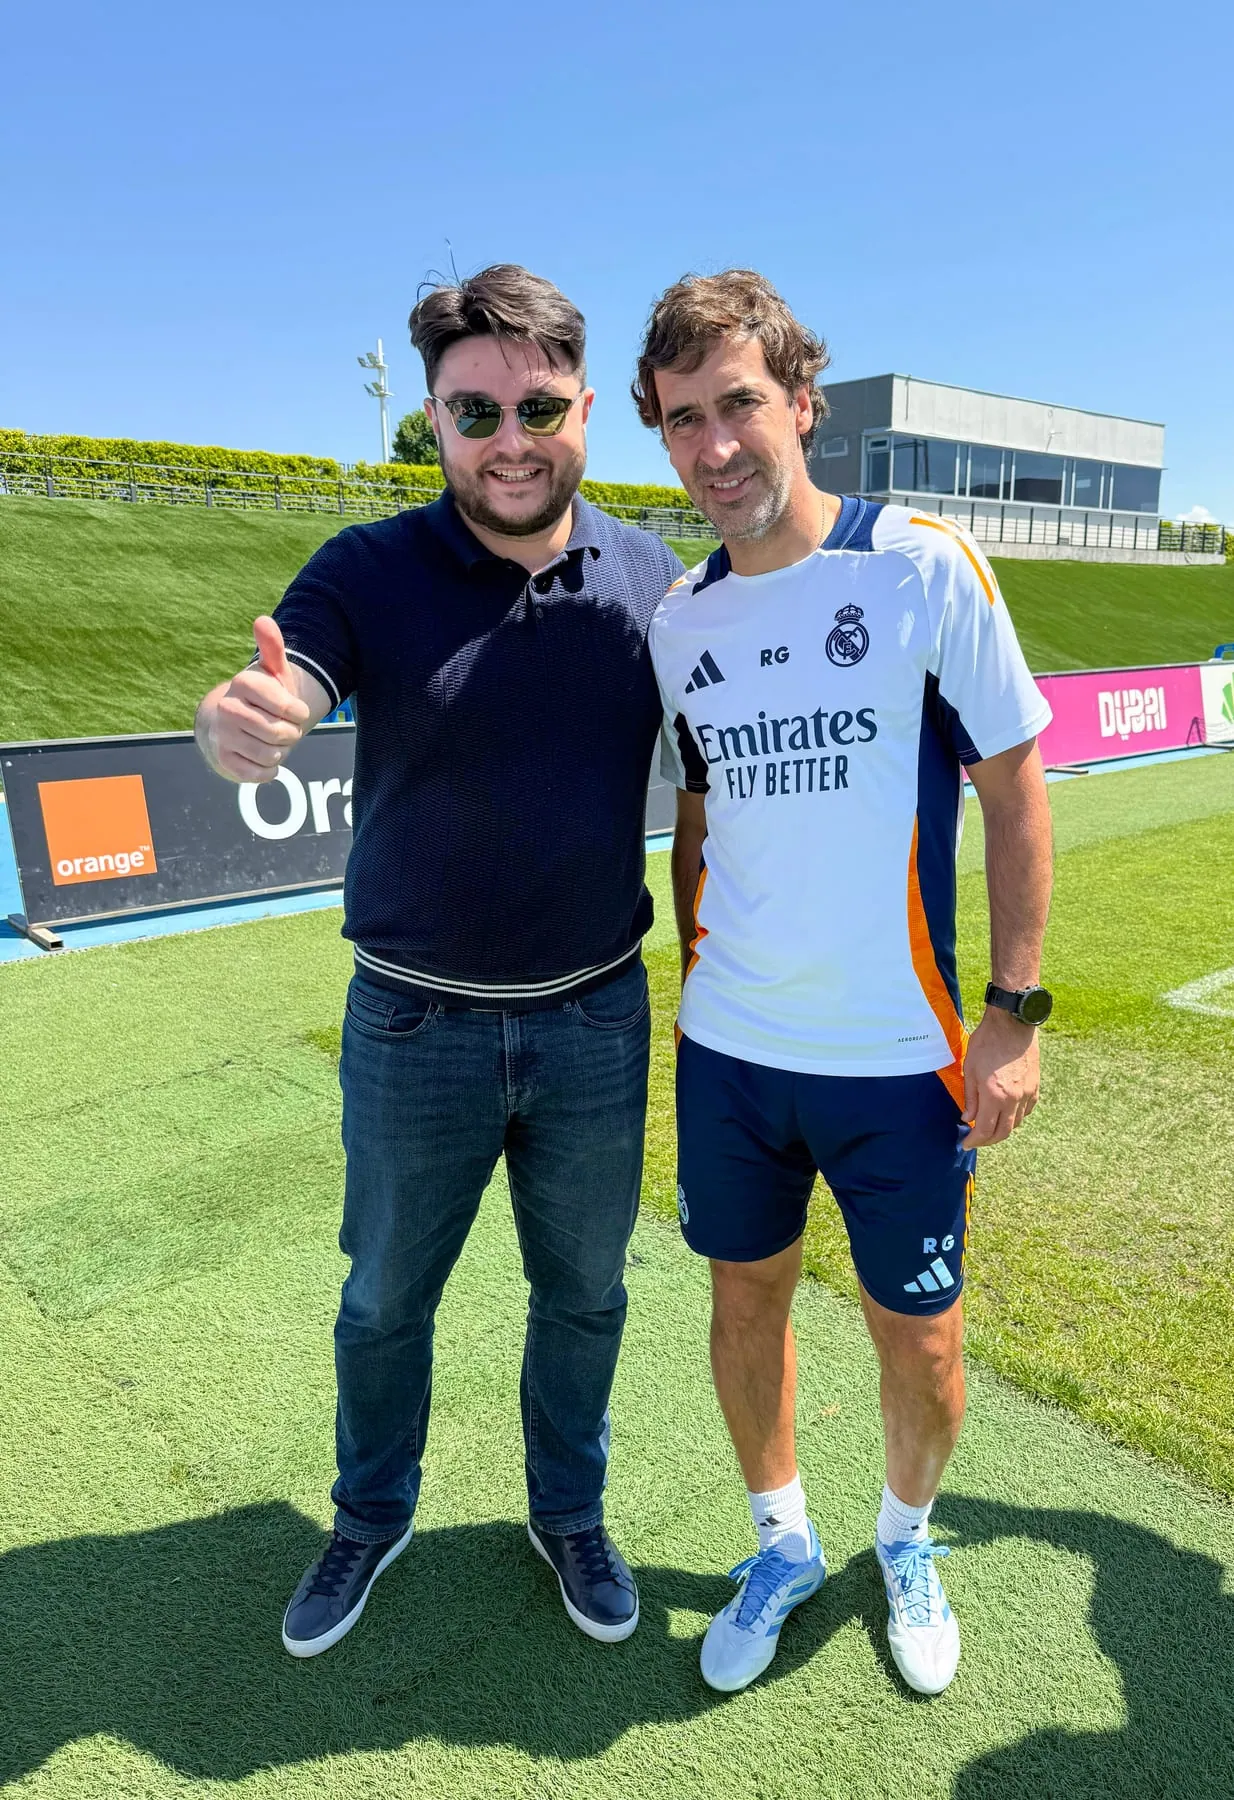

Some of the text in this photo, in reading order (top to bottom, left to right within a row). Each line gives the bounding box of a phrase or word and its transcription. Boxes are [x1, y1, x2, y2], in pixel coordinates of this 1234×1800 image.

[760, 646, 790, 667] RG
[697, 706, 878, 764] Emirates
[725, 755, 849, 800] FLY BETTER
[923, 1235, 955, 1253] RG
